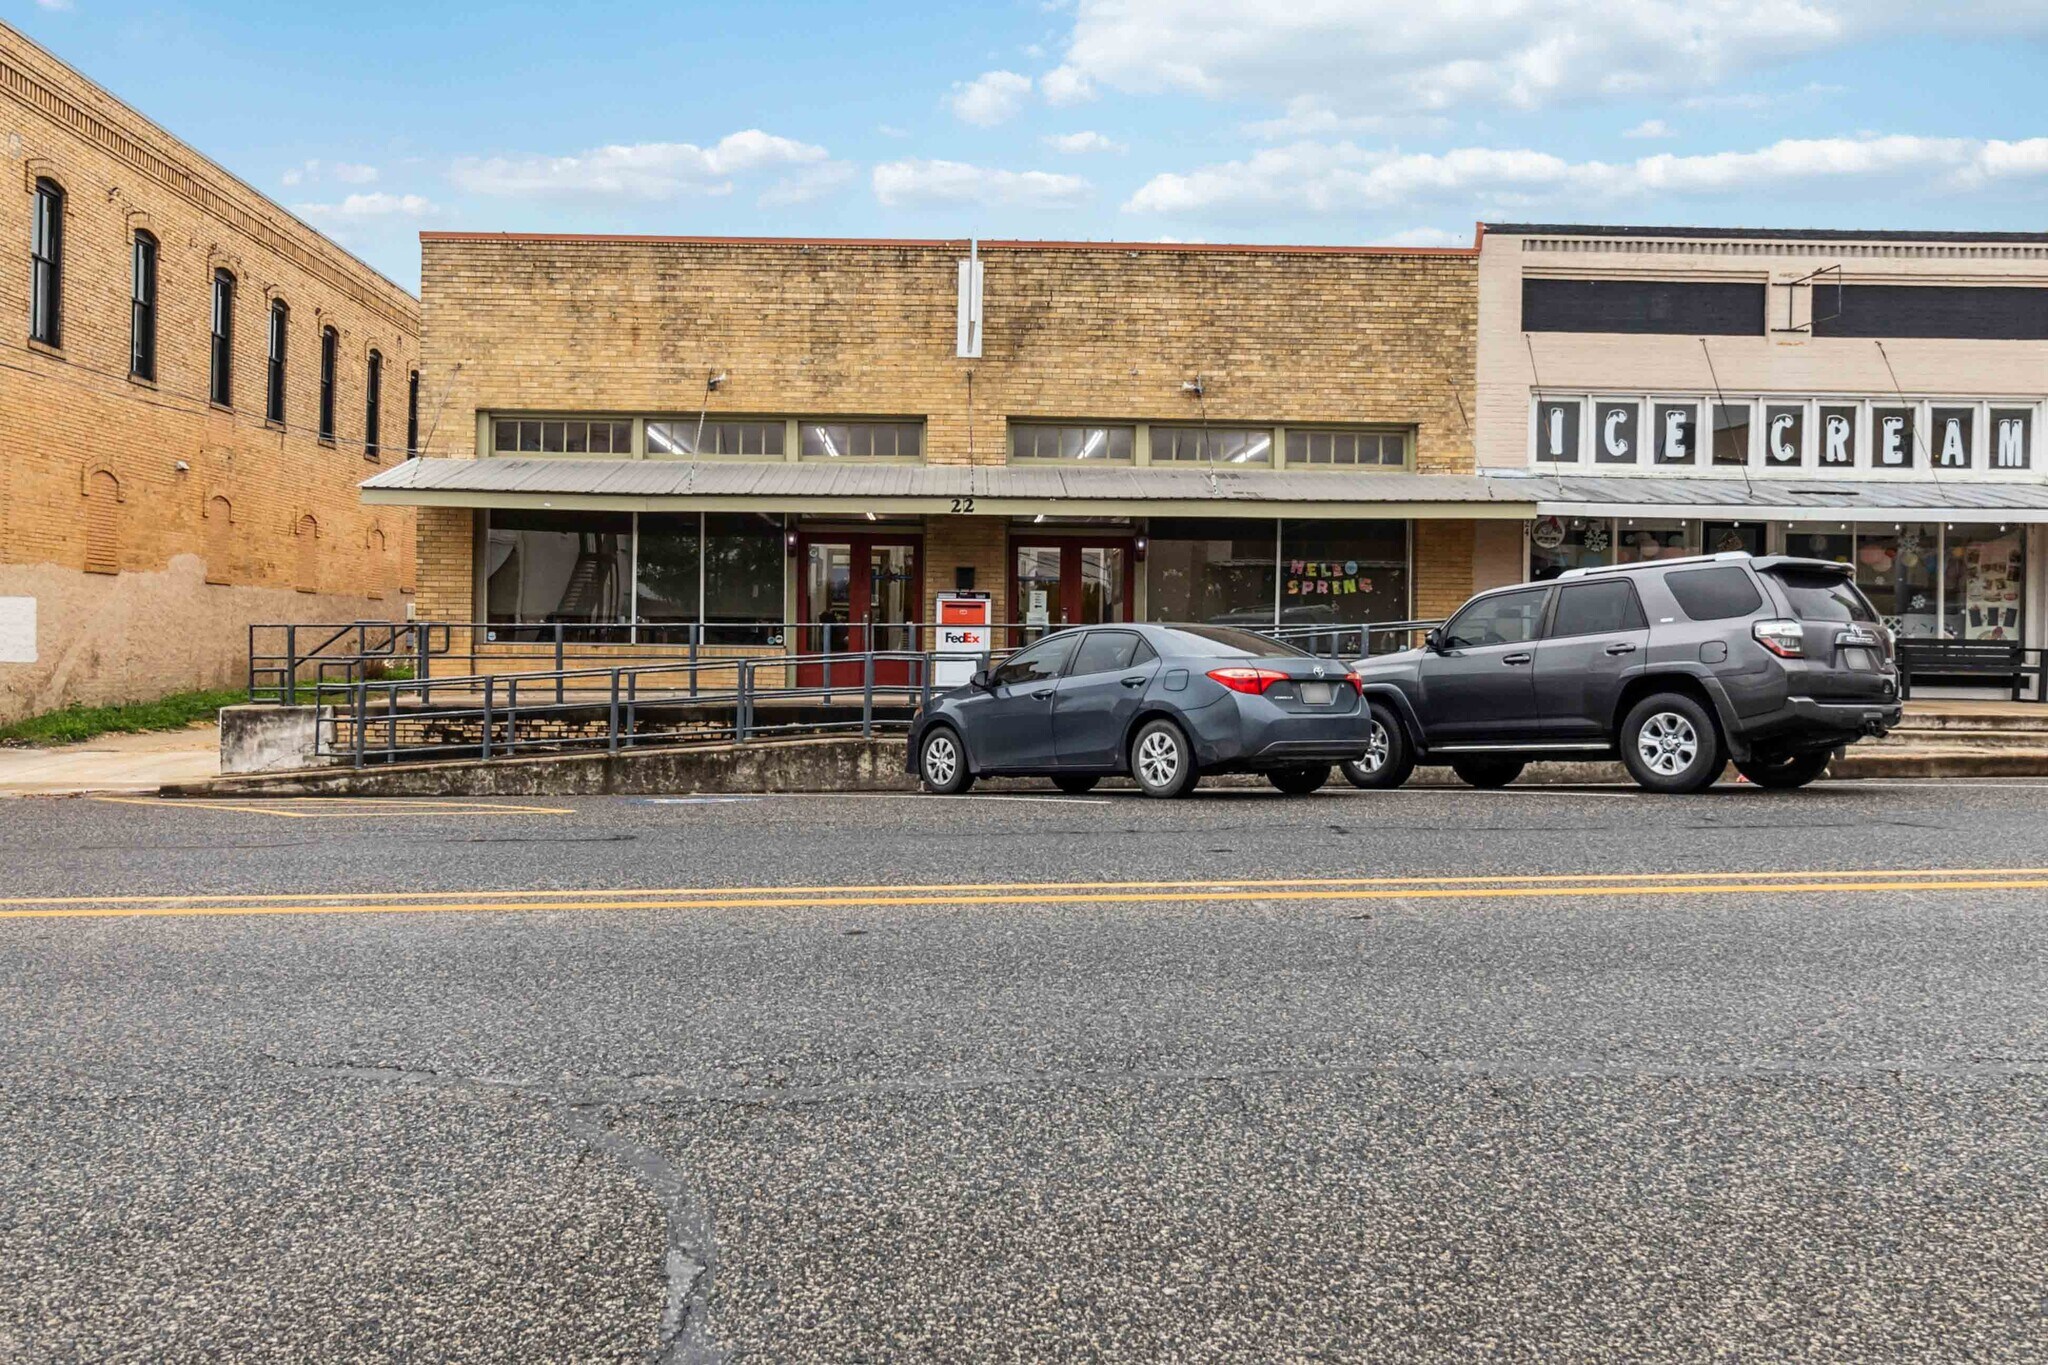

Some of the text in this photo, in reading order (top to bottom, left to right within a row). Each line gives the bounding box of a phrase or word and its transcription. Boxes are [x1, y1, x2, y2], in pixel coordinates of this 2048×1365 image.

[1550, 407, 2023, 467] ICE CREAM
[950, 498, 974, 513] 22
[1287, 578, 1373, 595] SPRING
[945, 632, 980, 643] FedEx
